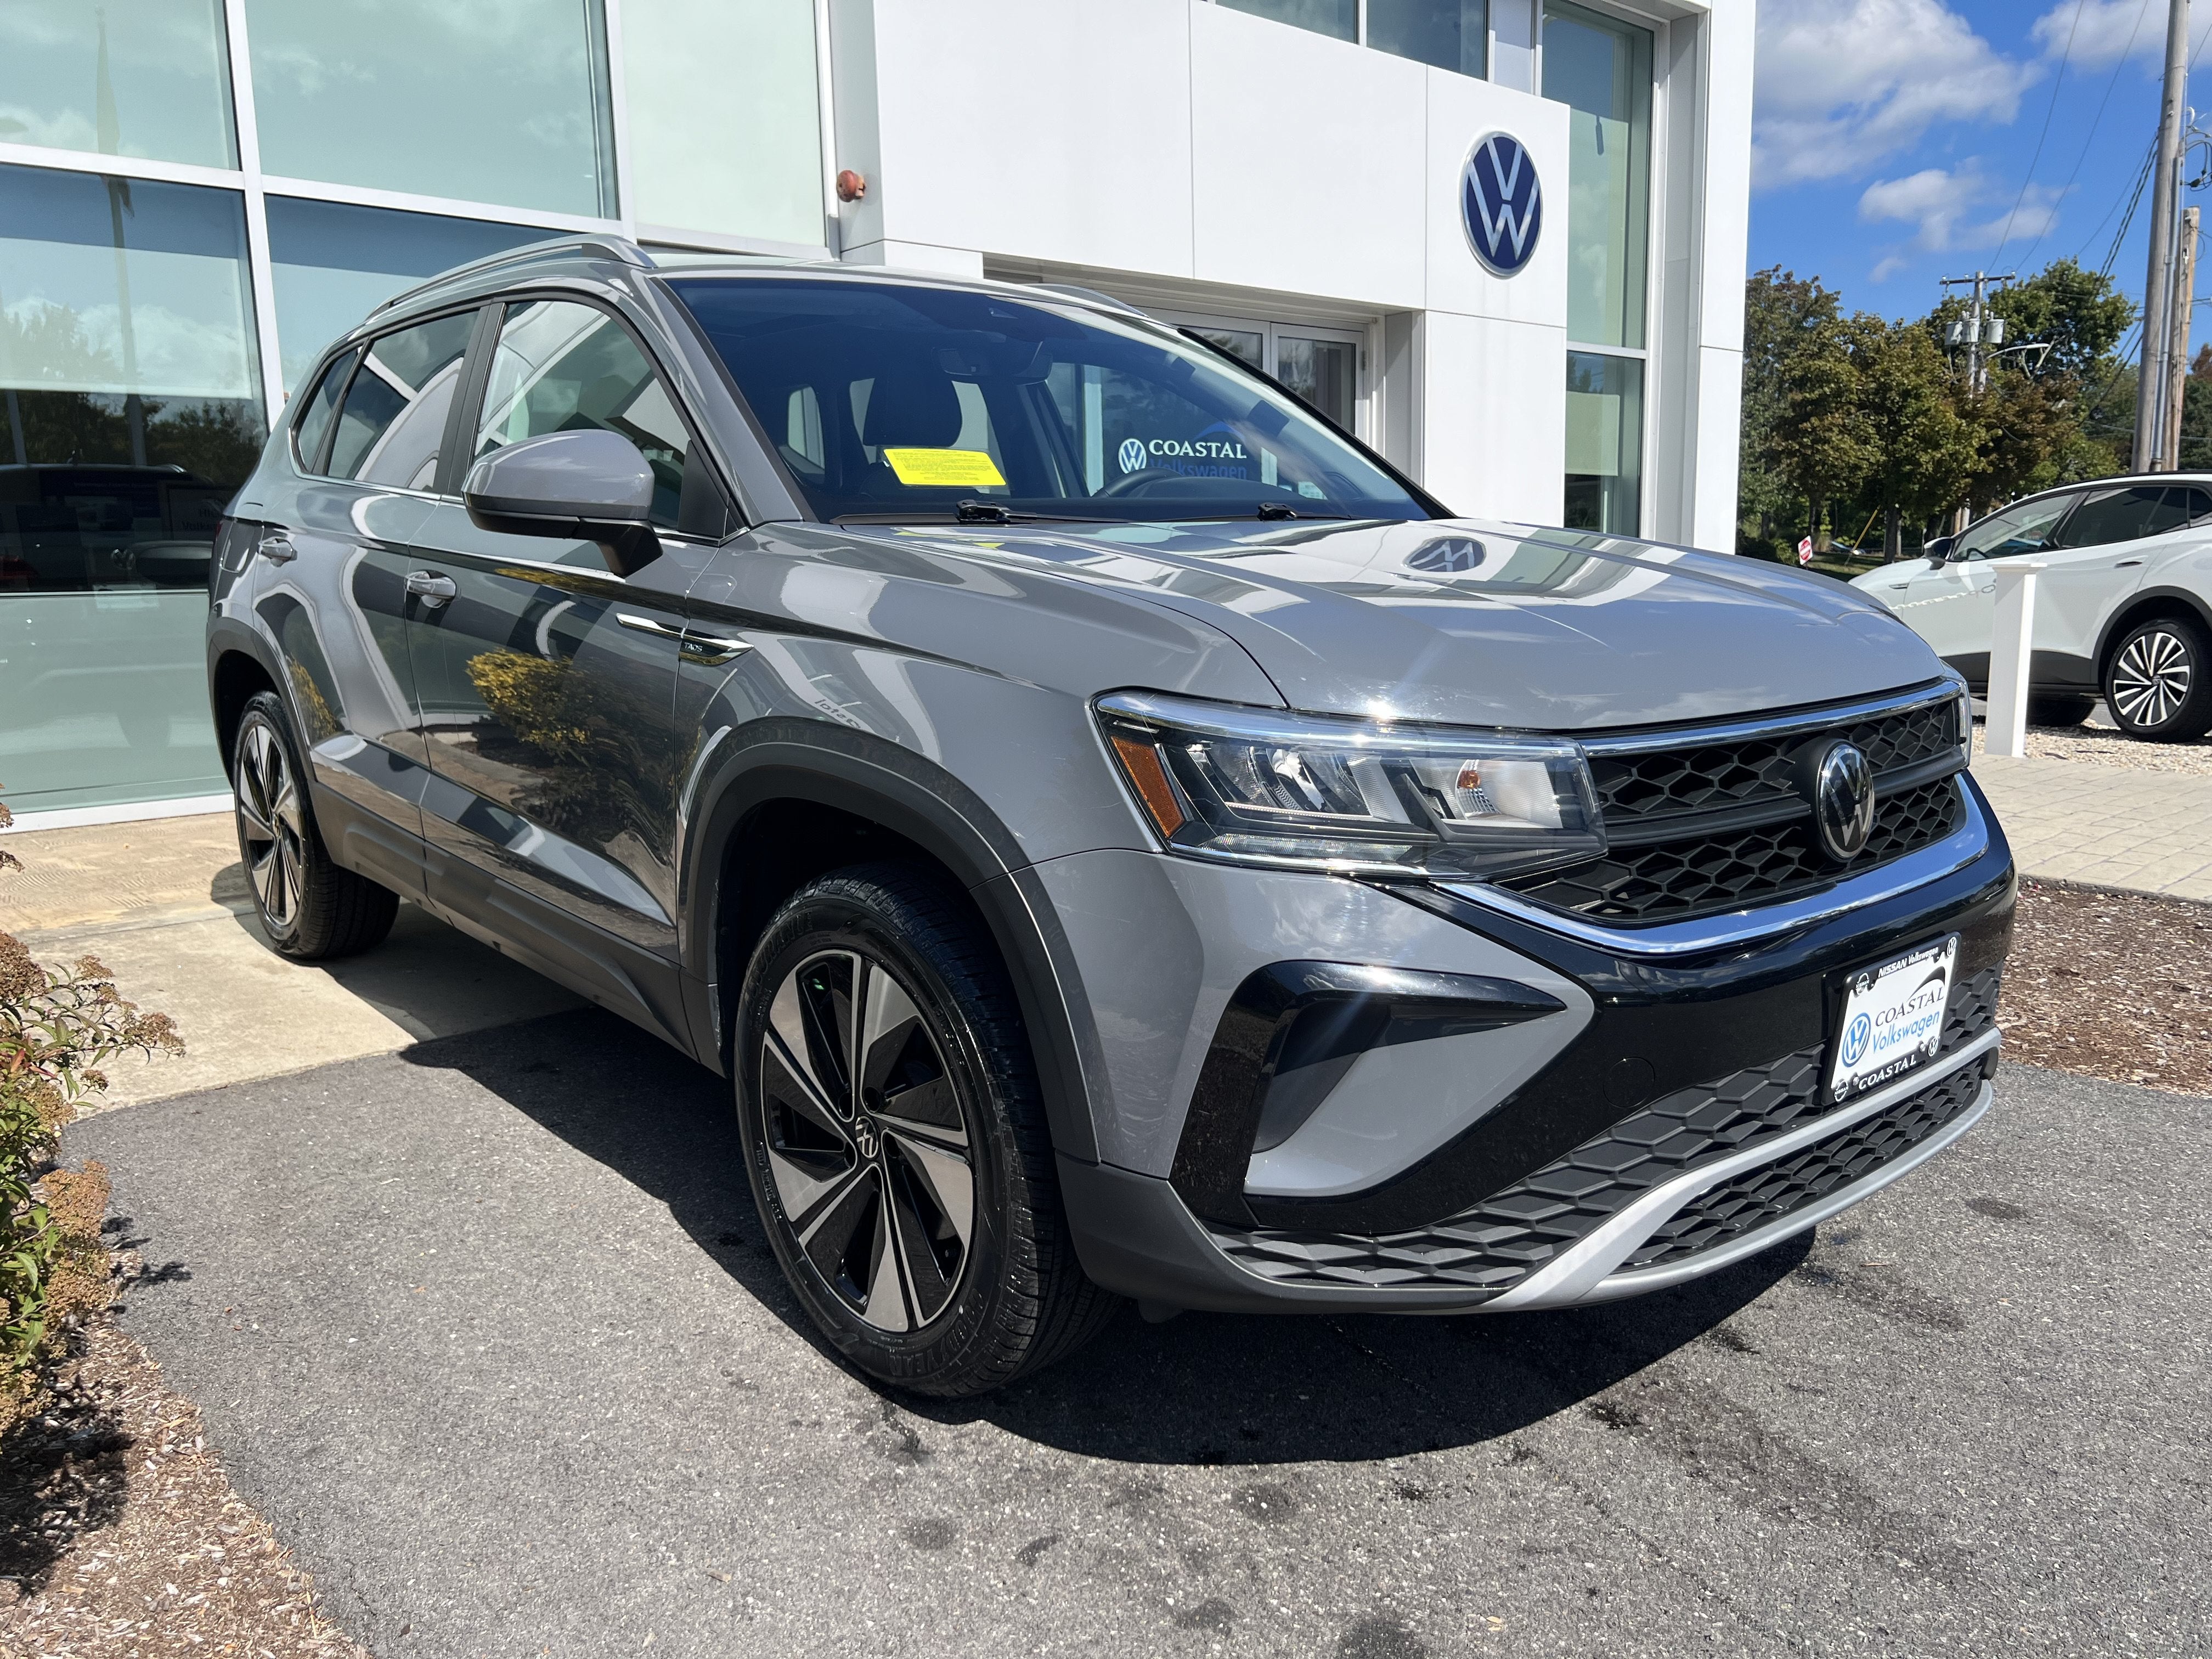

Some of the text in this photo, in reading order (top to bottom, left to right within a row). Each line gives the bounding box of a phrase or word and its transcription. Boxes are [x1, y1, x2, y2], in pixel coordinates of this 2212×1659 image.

[1148, 439, 1247, 459] COASTAL
[684, 642, 703, 653] TAOS
[1878, 947, 1939, 978] NISSAN Volkswagen
[1875, 986, 1944, 1027] COASTAL
[1872, 1011, 1940, 1054] Volkswagen
[1859, 1054, 1917, 1090] COASTAL
